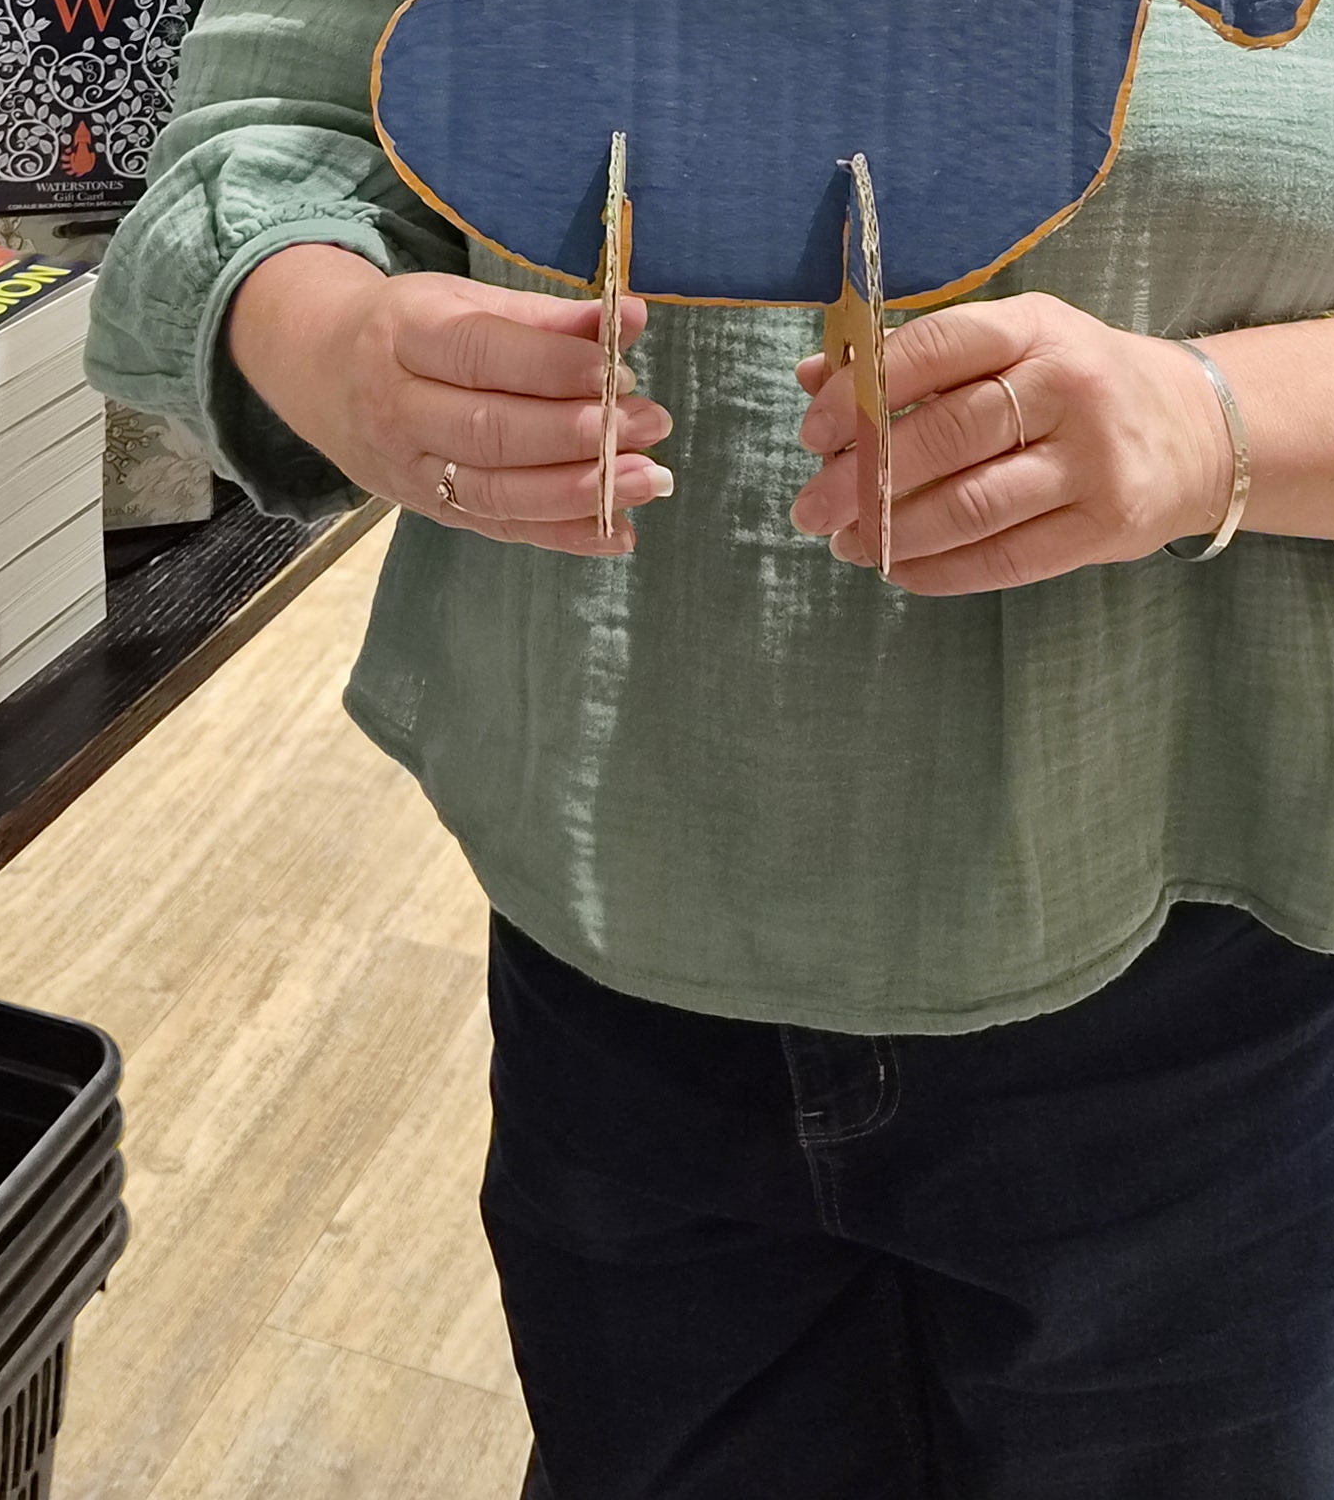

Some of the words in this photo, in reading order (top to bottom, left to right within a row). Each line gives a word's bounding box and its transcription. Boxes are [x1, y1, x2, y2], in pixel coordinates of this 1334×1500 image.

[36, 180, 124, 192] WATERSTONES
[53, 192, 75, 202] Gift
[77, 192, 104, 201] Card
